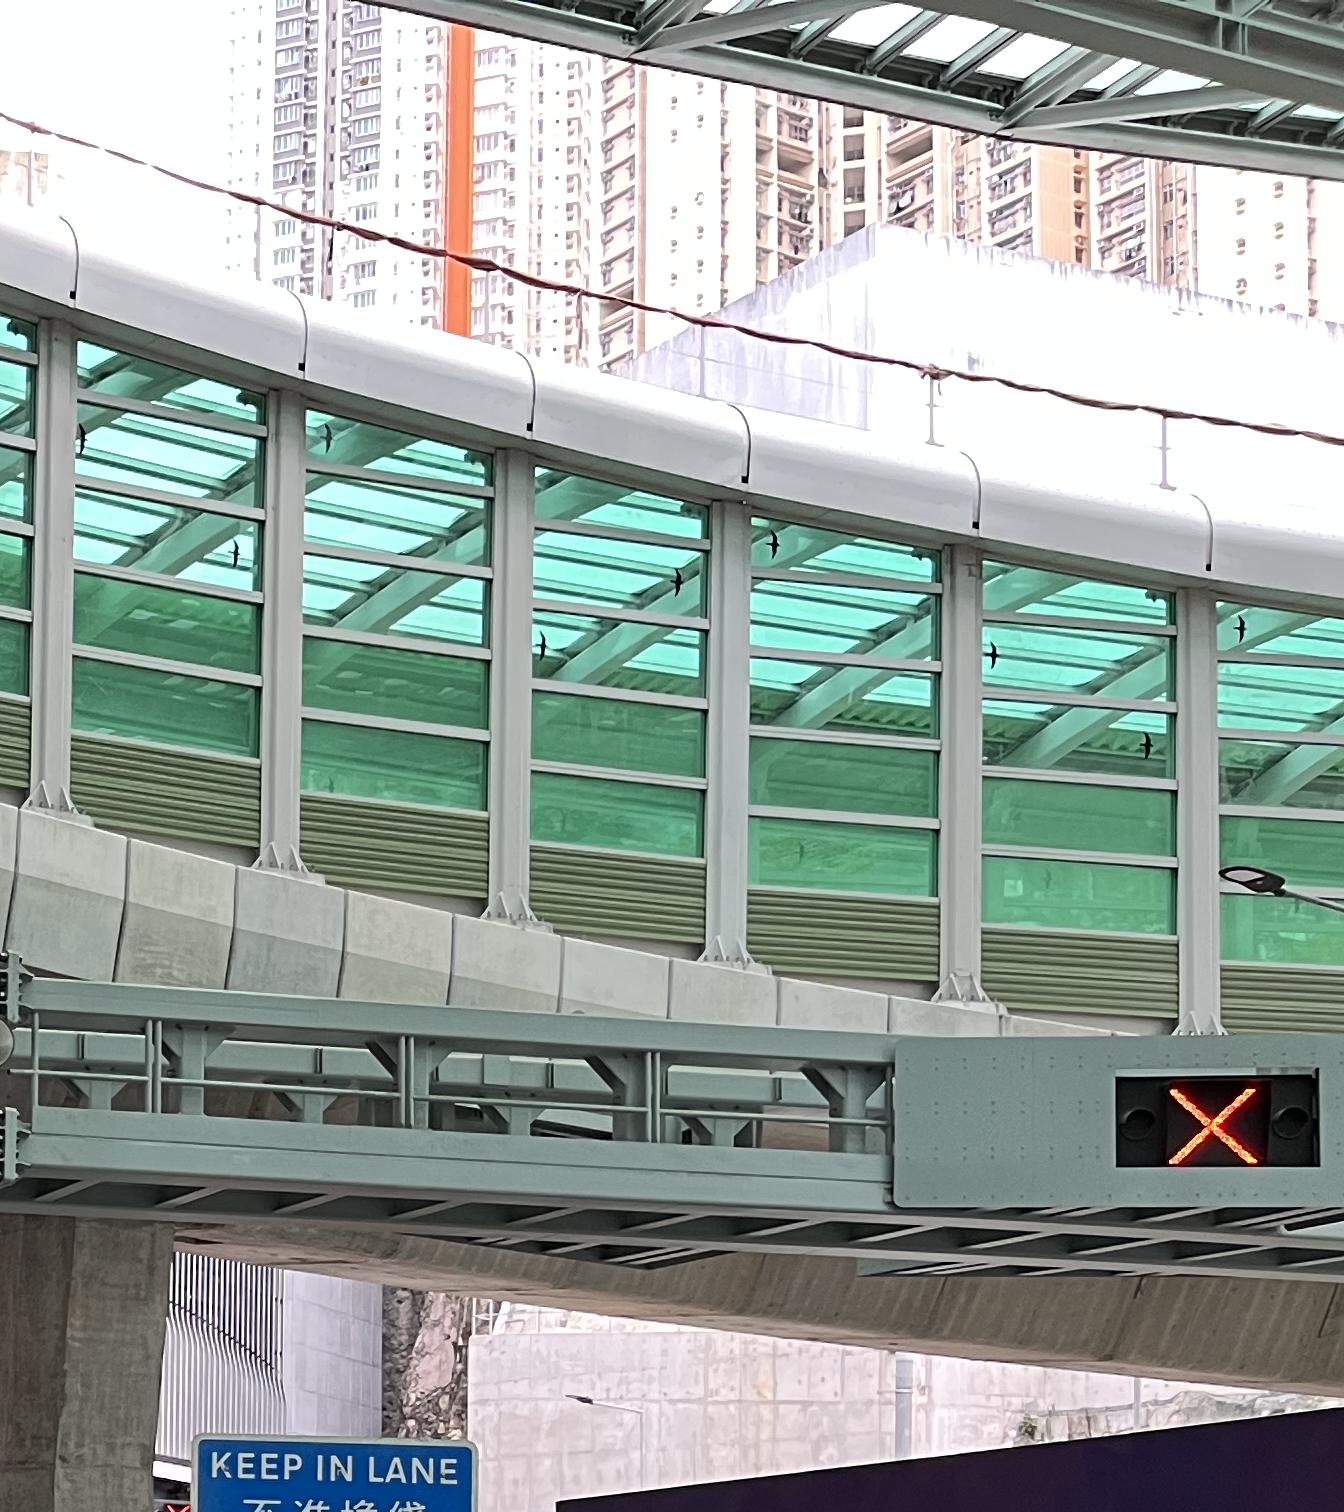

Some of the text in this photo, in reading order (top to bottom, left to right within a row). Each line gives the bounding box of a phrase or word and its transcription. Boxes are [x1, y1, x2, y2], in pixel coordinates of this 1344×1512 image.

[211, 1451, 459, 1485] KEEP IN LANE
